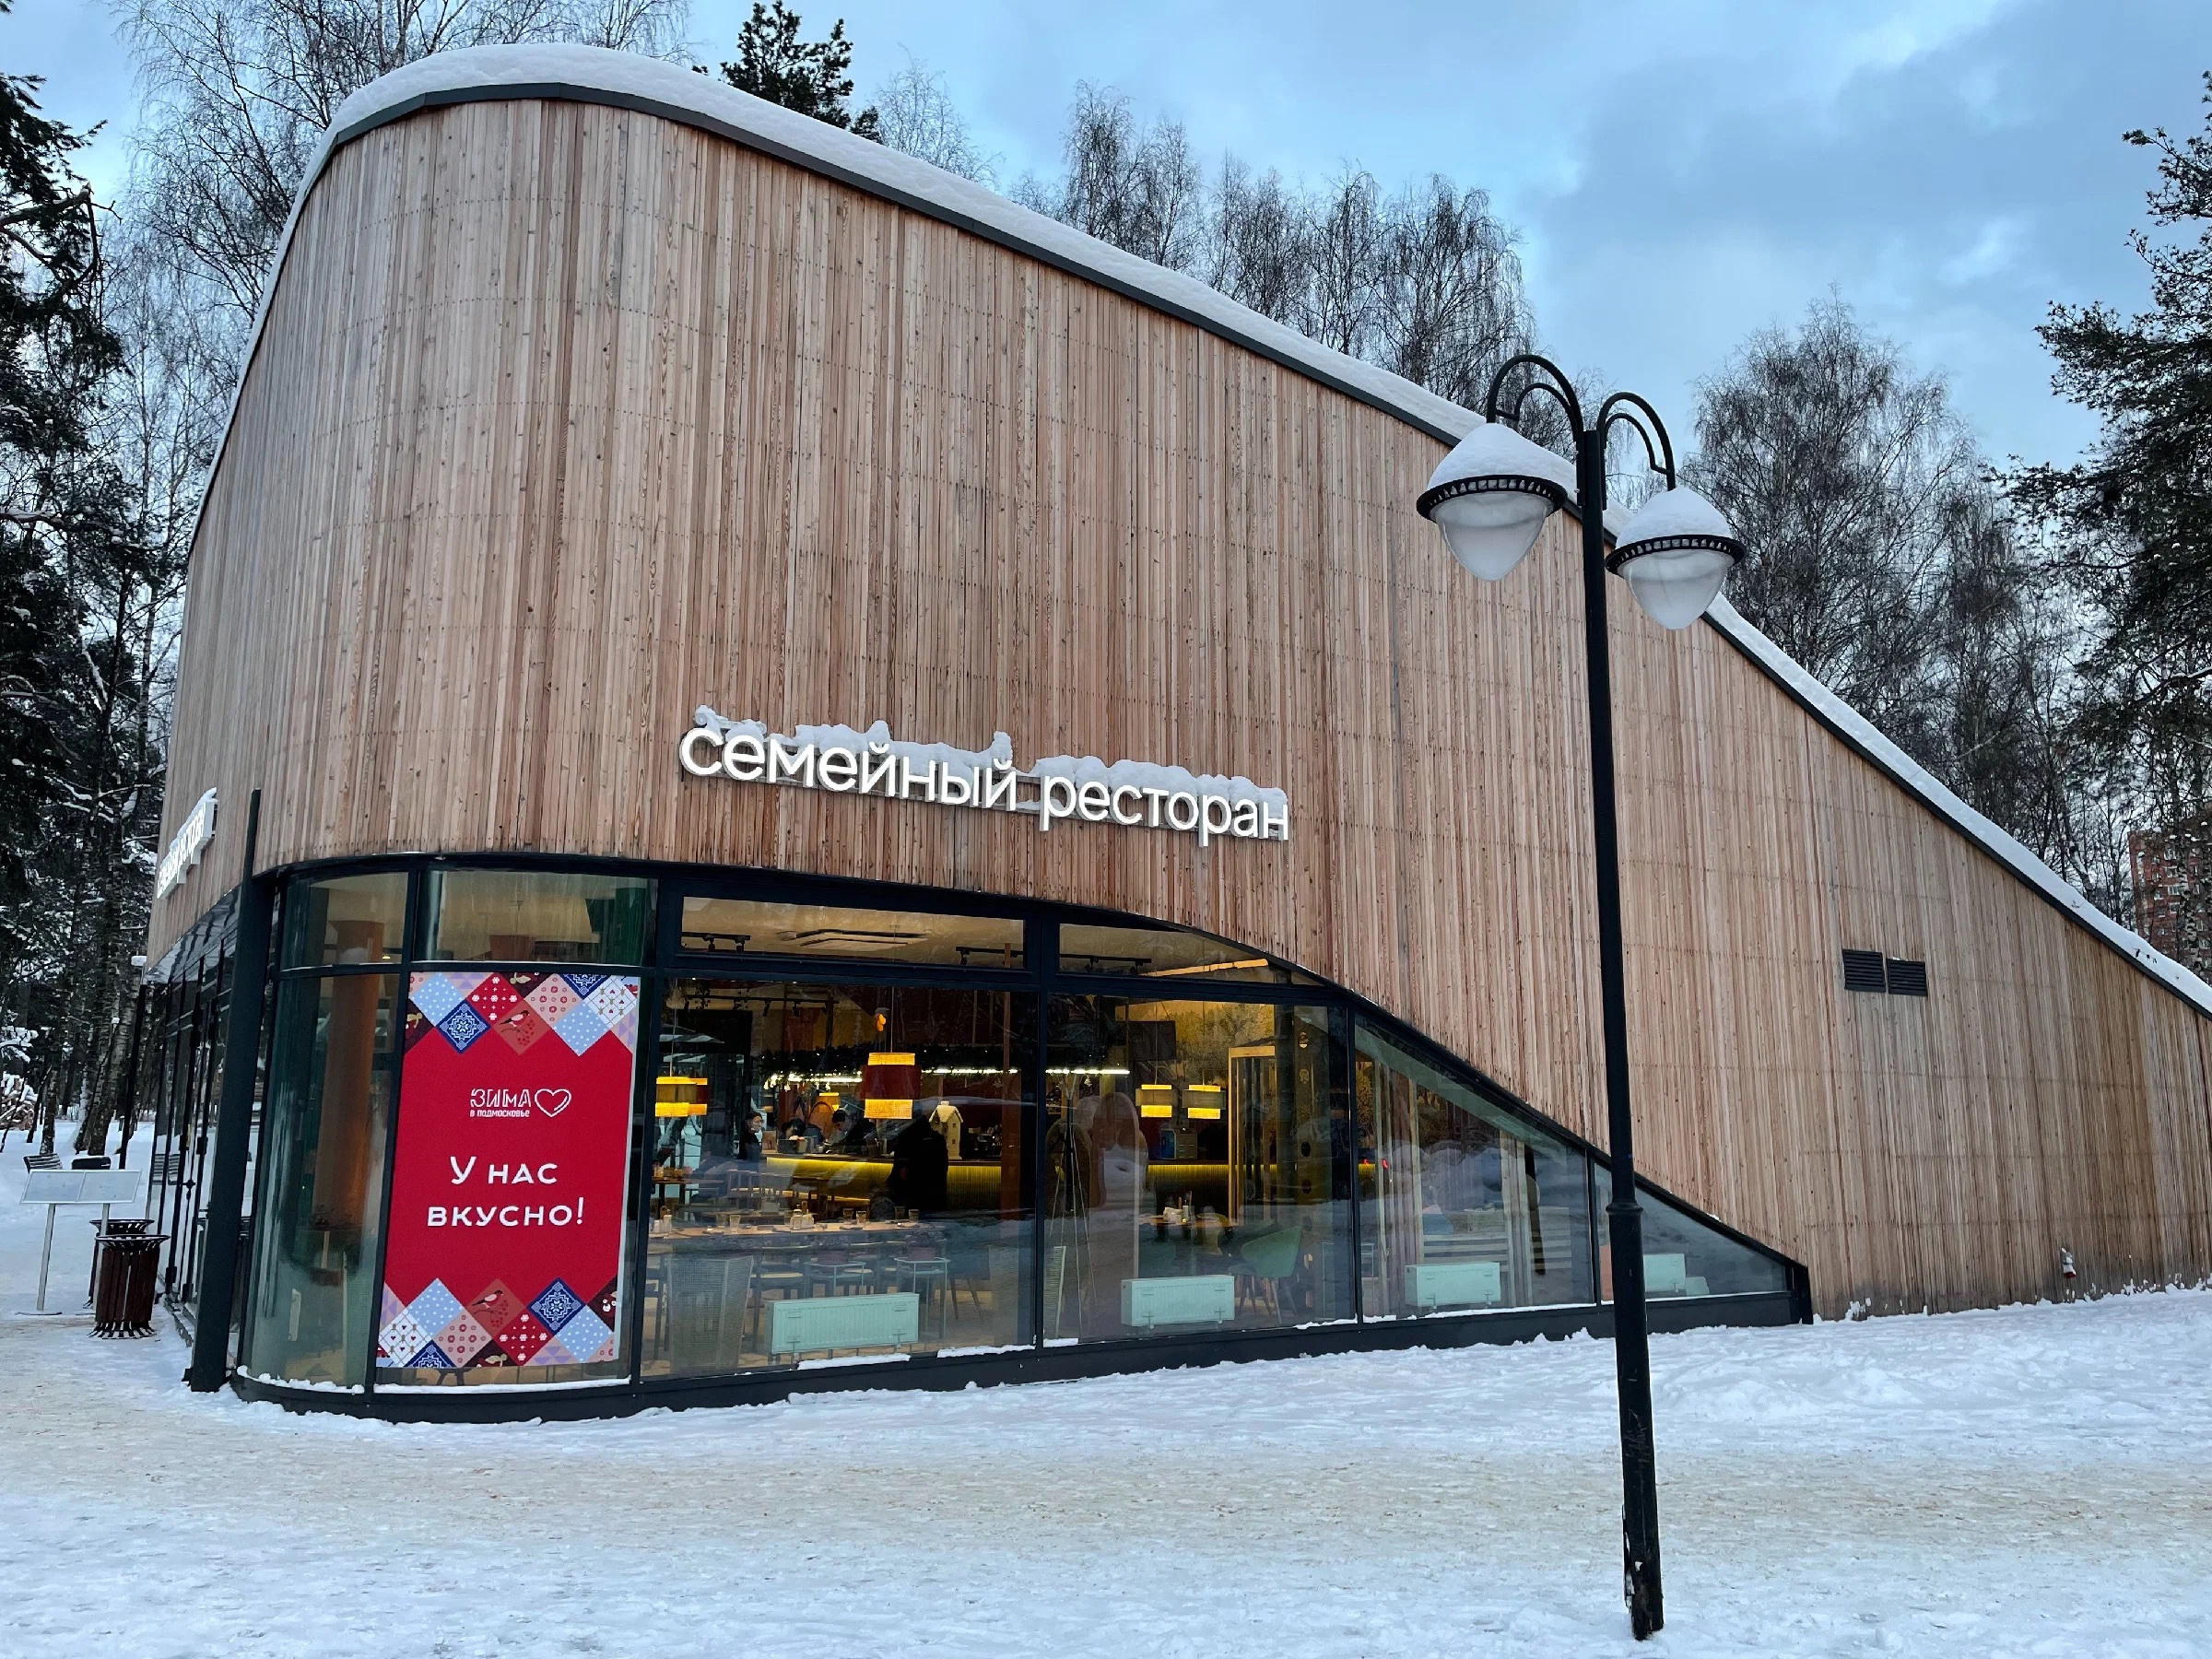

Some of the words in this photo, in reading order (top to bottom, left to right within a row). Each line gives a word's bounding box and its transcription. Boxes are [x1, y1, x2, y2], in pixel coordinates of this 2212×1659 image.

[680, 727, 1017, 811] семейный
[1041, 775, 1288, 847] ресторан
[470, 1088, 532, 1108] ЗИМА
[450, 1156, 477, 1185] У
[427, 1196, 584, 1227] ВКУСНО!
